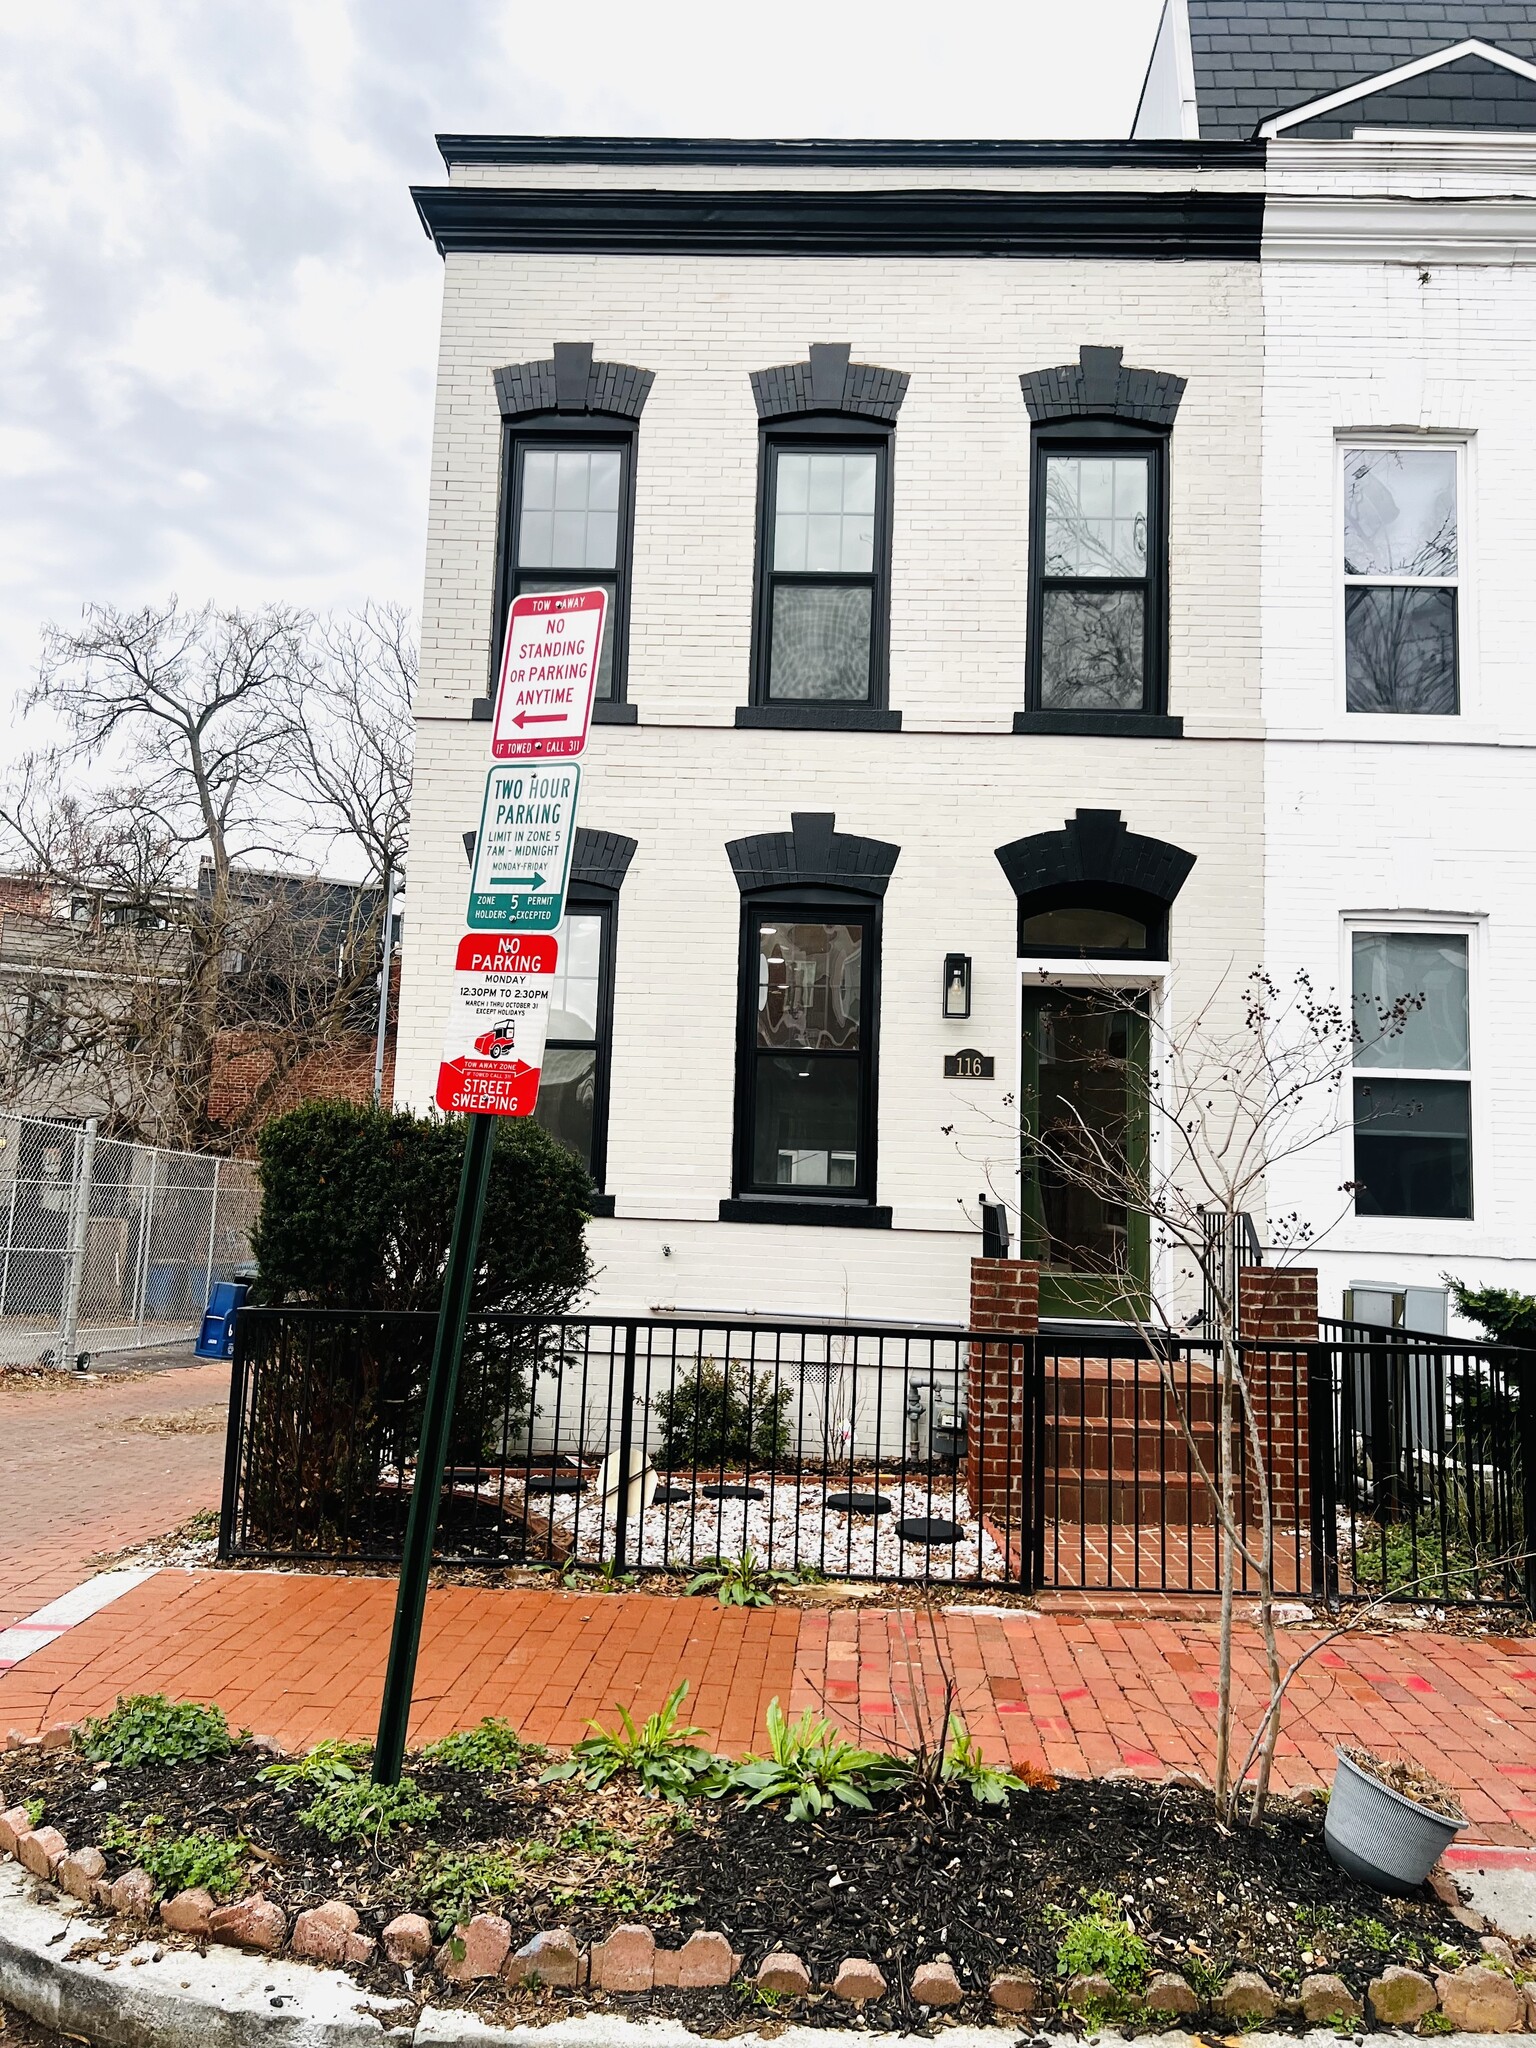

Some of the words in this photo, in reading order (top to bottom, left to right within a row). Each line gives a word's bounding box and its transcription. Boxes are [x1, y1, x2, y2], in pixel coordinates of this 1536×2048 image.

[532, 600, 551, 612] TOW
[562, 597, 585, 609] AWAY
[546, 618, 565, 635] NO
[519, 639, 585, 660] STANDING
[510, 670, 526, 683] OR
[528, 663, 588, 682] PARKING
[516, 687, 574, 706] ANYTIME
[496, 743, 504, 755] IF
[507, 742, 532, 754] TOWED
[546, 741, 565, 753] CALL
[568, 740, 580, 752] 311
[495, 779, 523, 799] TWO
[529, 778, 570, 799] HOUR
[496, 803, 562, 825] PARKING
[488, 831, 512, 842] LIMIT
[514, 831, 524, 842] IN
[526, 831, 551, 842] ZONE
[554, 830, 561, 842] 5
[486, 845, 505, 856] 7AM
[515, 845, 560, 856] MIDNIGHT
[477, 896, 496, 905] ZONE
[510, 894, 519, 910] 5
[527, 896, 554, 905] PERMIT
[475, 910, 507, 919] HOLDERS
[516, 911, 552, 920] EXCEPTED
[498, 937, 521, 955] NO
[471, 954, 542, 972] PARKING
[484, 974, 526, 984] MONDAY
[460, 987, 497, 997] 12:30PM
[500, 989, 512, 998] TO
[514, 989, 549, 999] 2:30PM
[505, 1001, 531, 1009] OCTOBER
[956, 1057, 982, 1076] 116
[463, 1078, 512, 1095] STREET
[451, 1092, 518, 1111] SWEEPING
